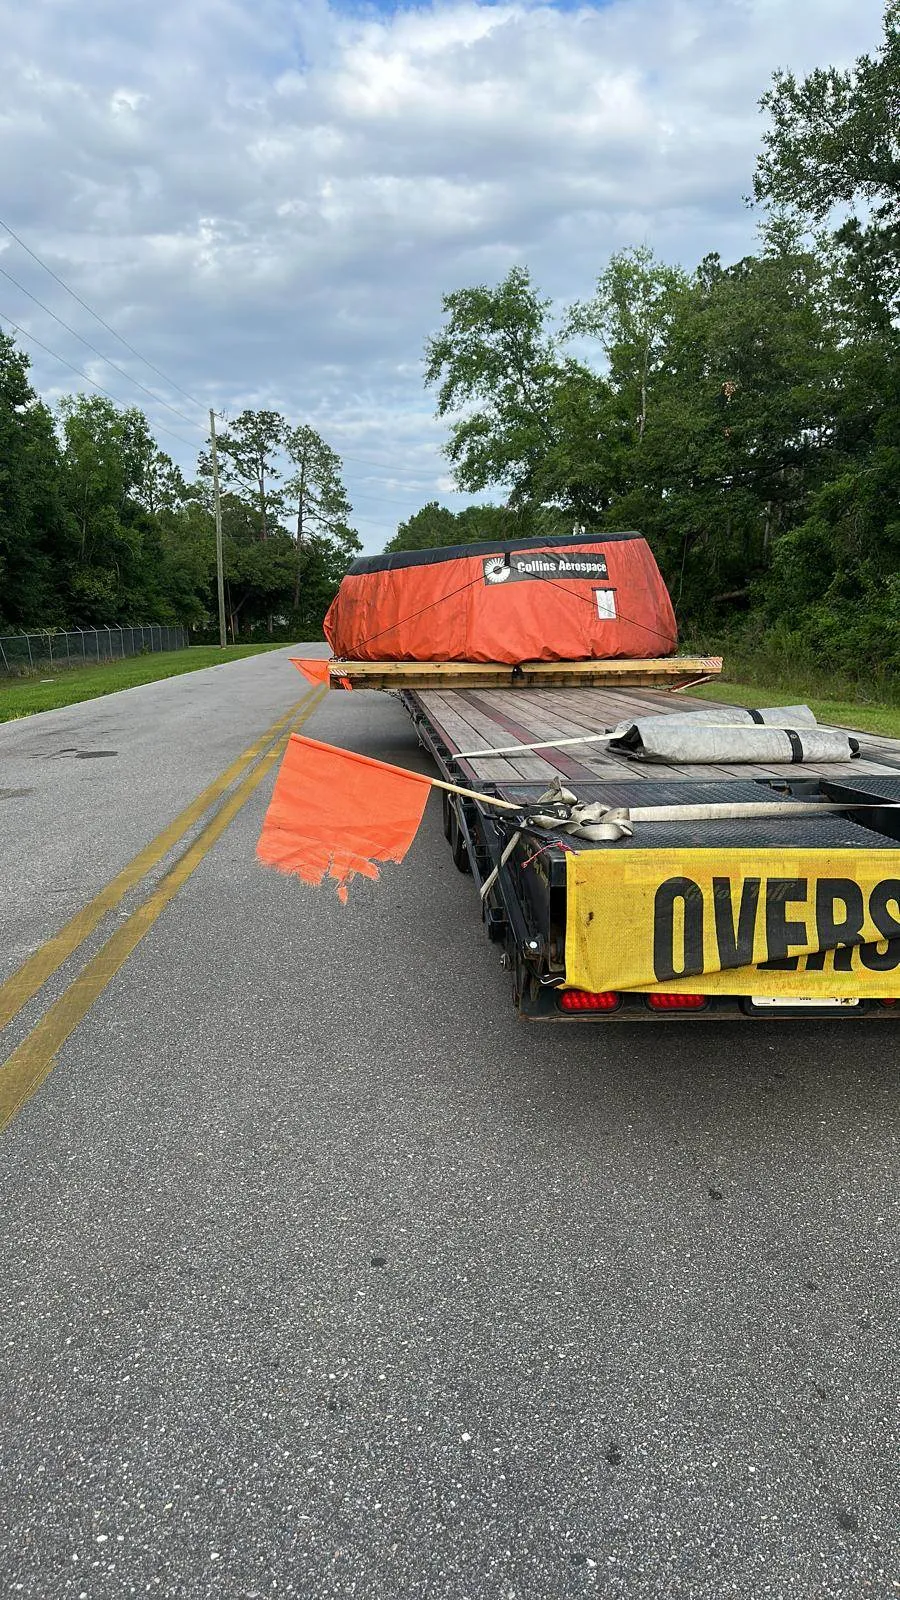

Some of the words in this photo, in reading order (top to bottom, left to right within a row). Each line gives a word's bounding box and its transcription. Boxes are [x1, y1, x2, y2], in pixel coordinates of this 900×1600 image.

[517, 560, 557, 573] Collins
[558, 560, 607, 573] Aerospace
[653, 876, 900, 982] OVERS
